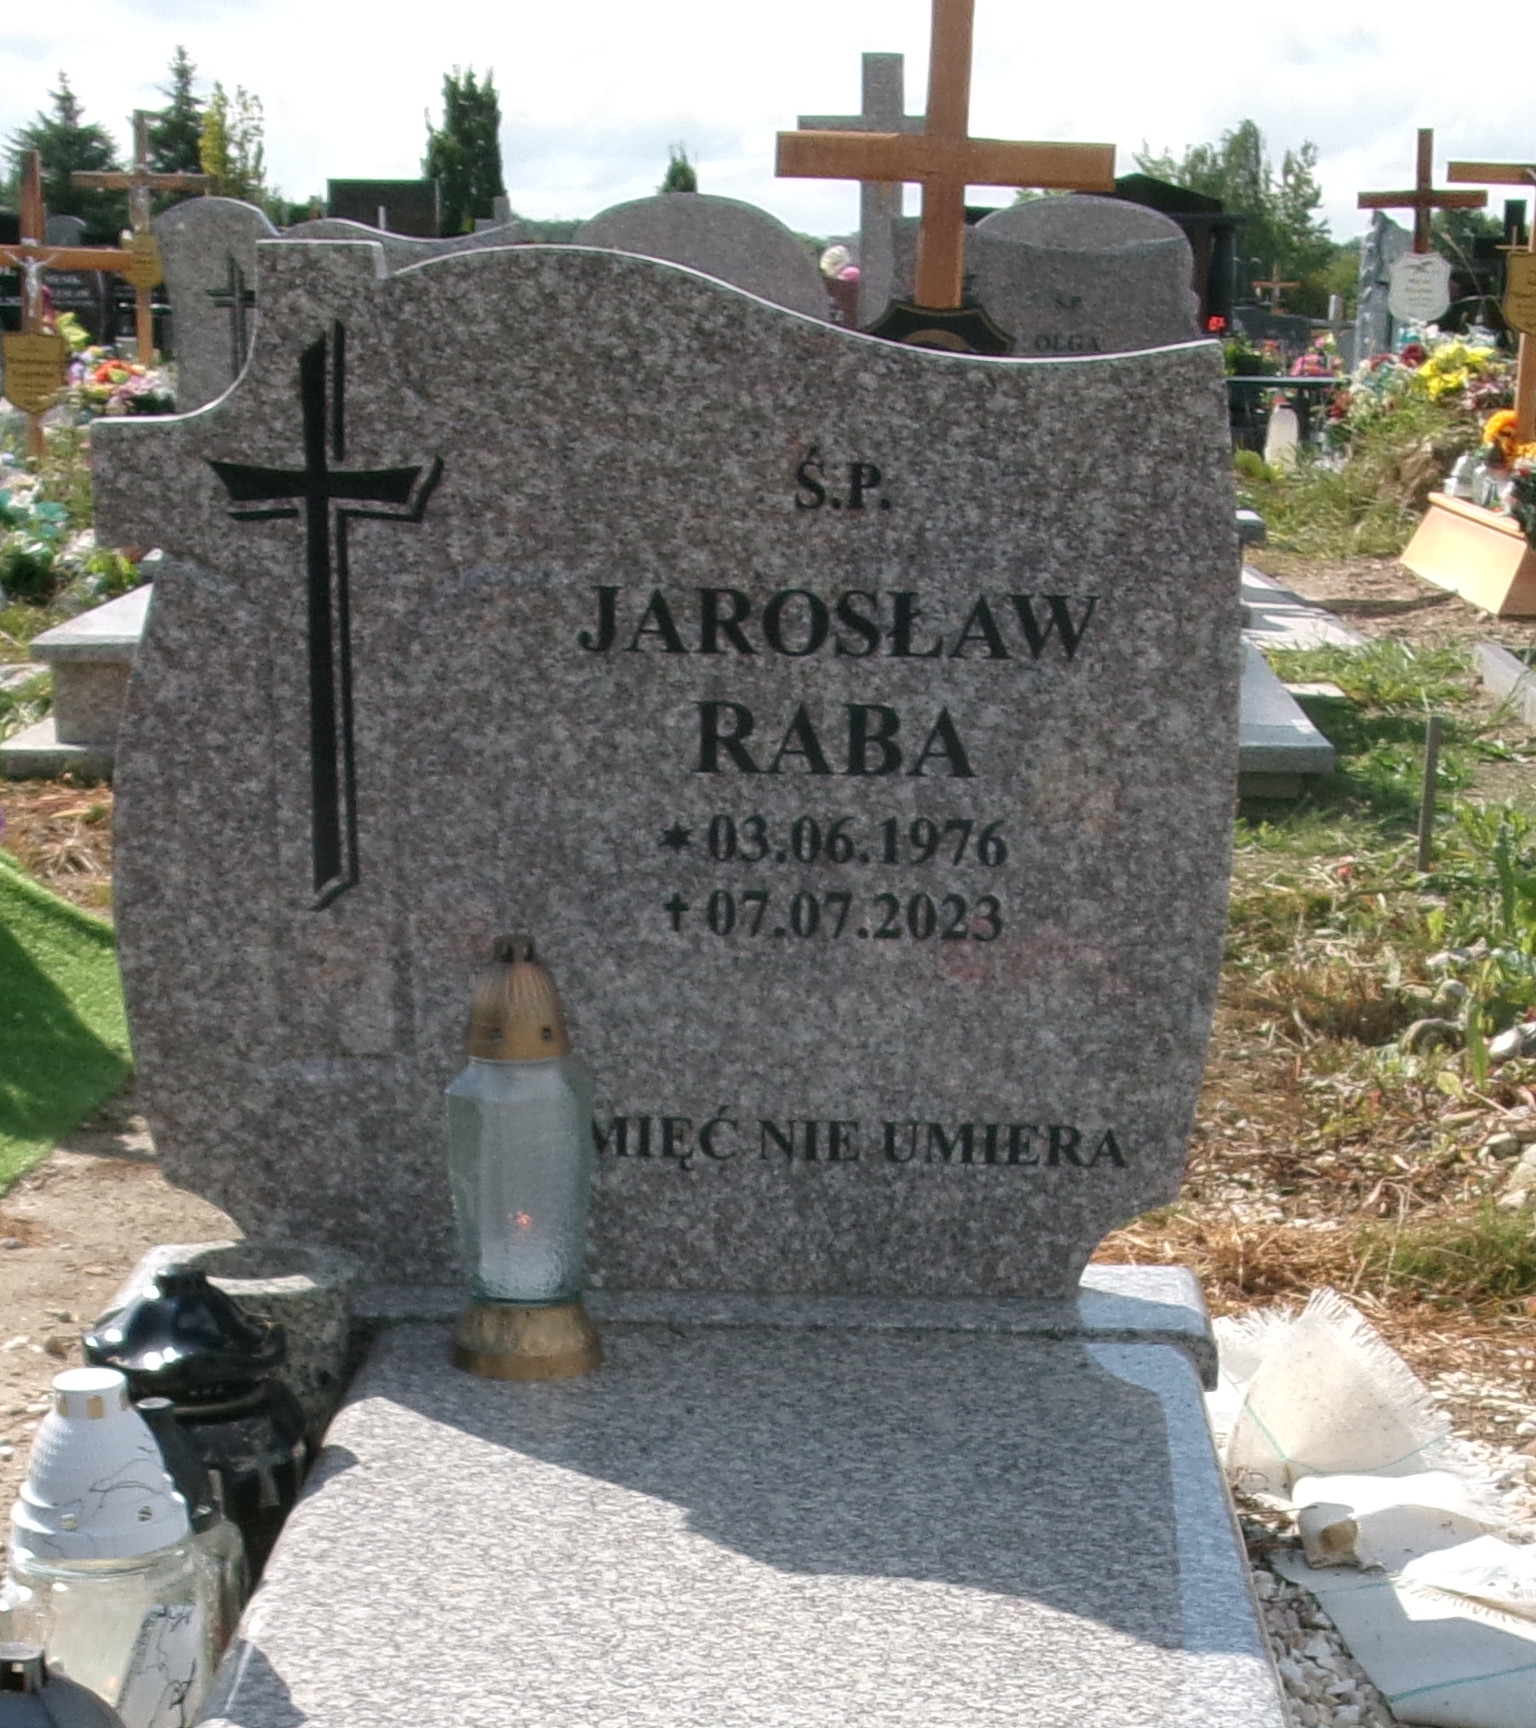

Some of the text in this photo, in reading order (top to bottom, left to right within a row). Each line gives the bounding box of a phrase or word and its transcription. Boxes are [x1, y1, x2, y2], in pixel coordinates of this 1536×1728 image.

[1034, 334, 1103, 351] OLGA
[794, 446, 892, 511] Ś.P.
[577, 584, 1102, 662] JAROSŁAW
[691, 700, 978, 778] RABA
[706, 813, 1009, 868] 03.06.1976
[704, 889, 1005, 943] 07.07.2023
[591, 1106, 1130, 1171] MIĘĆ NIE UMIERA
